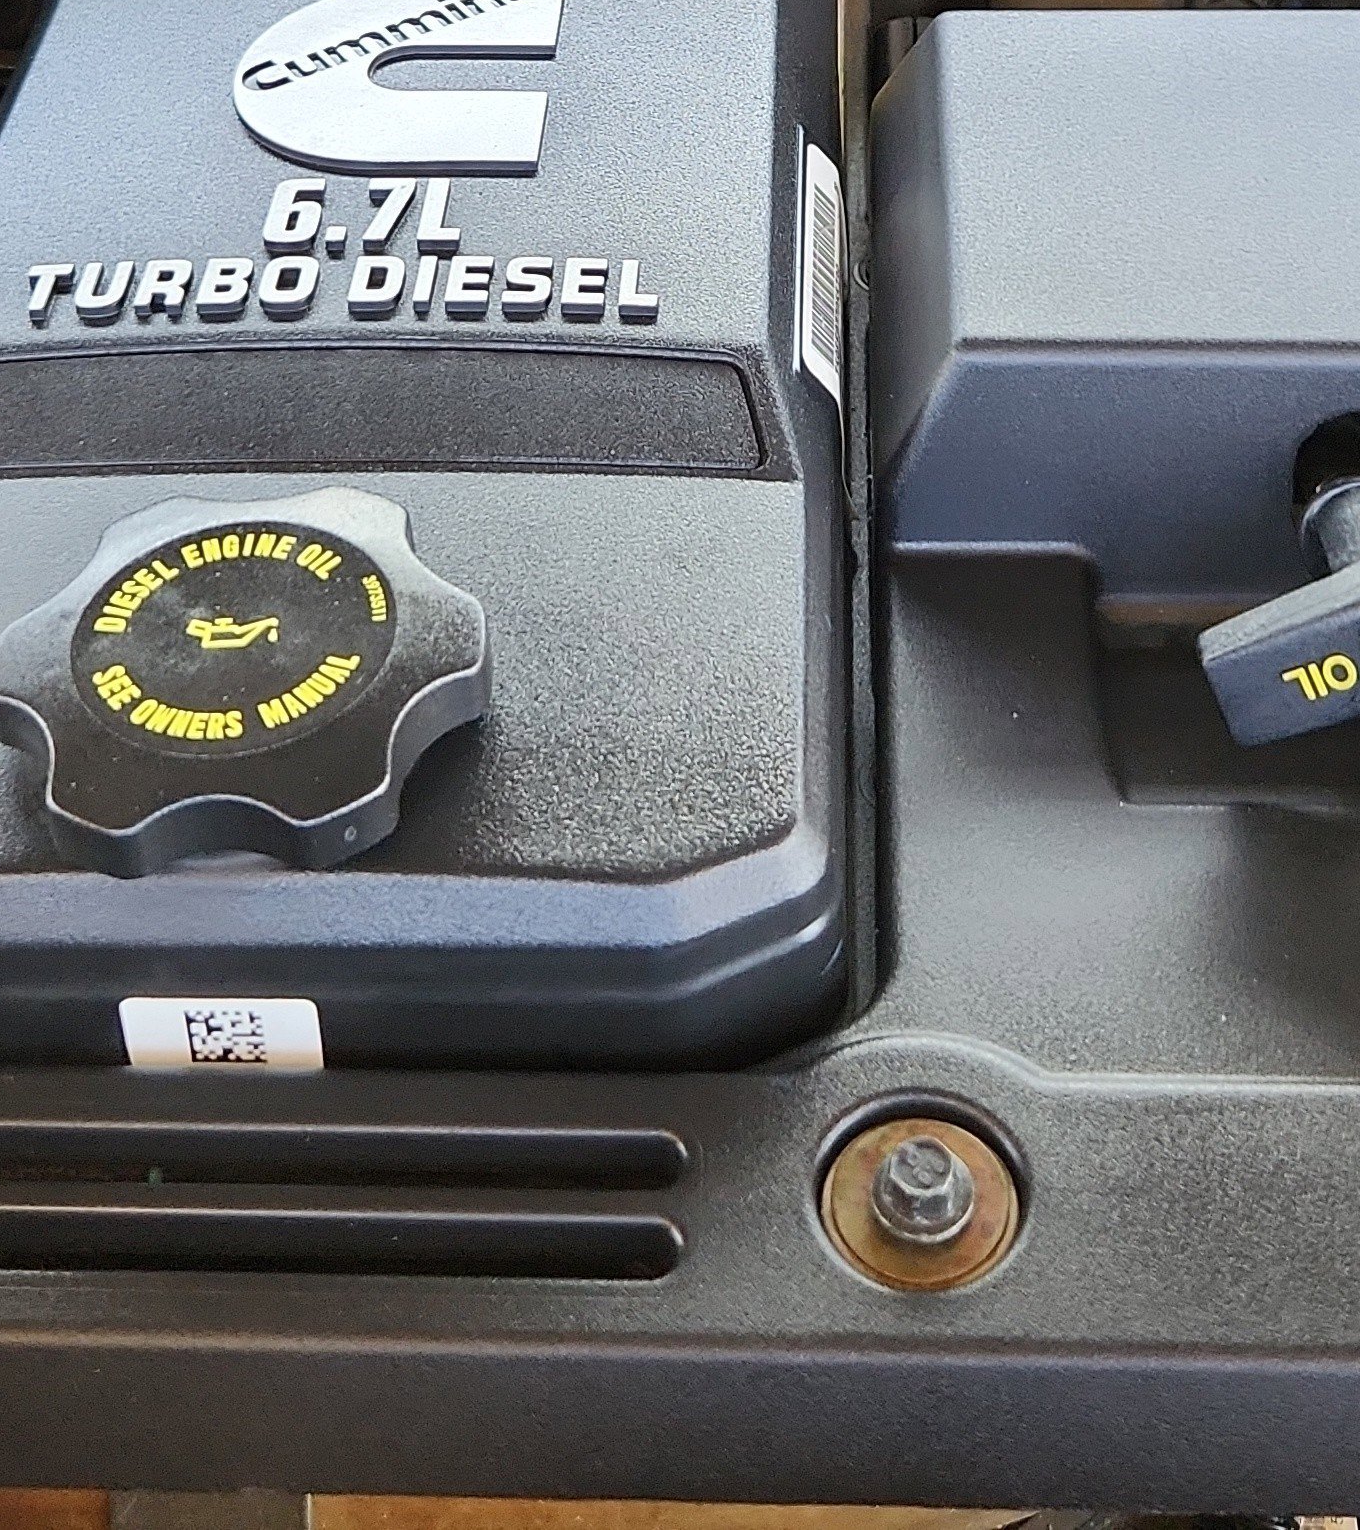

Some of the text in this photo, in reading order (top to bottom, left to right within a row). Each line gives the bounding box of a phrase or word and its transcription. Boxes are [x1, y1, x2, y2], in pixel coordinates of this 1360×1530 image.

[262, 177, 462, 258] 6.7L
[26, 255, 659, 325] TURBO DIESEL
[93, 533, 342, 633] DIESEL ENGINE OIL
[92, 655, 361, 740] SEE OWNERS MANUAL
[1281, 654, 1358, 701] OIL
